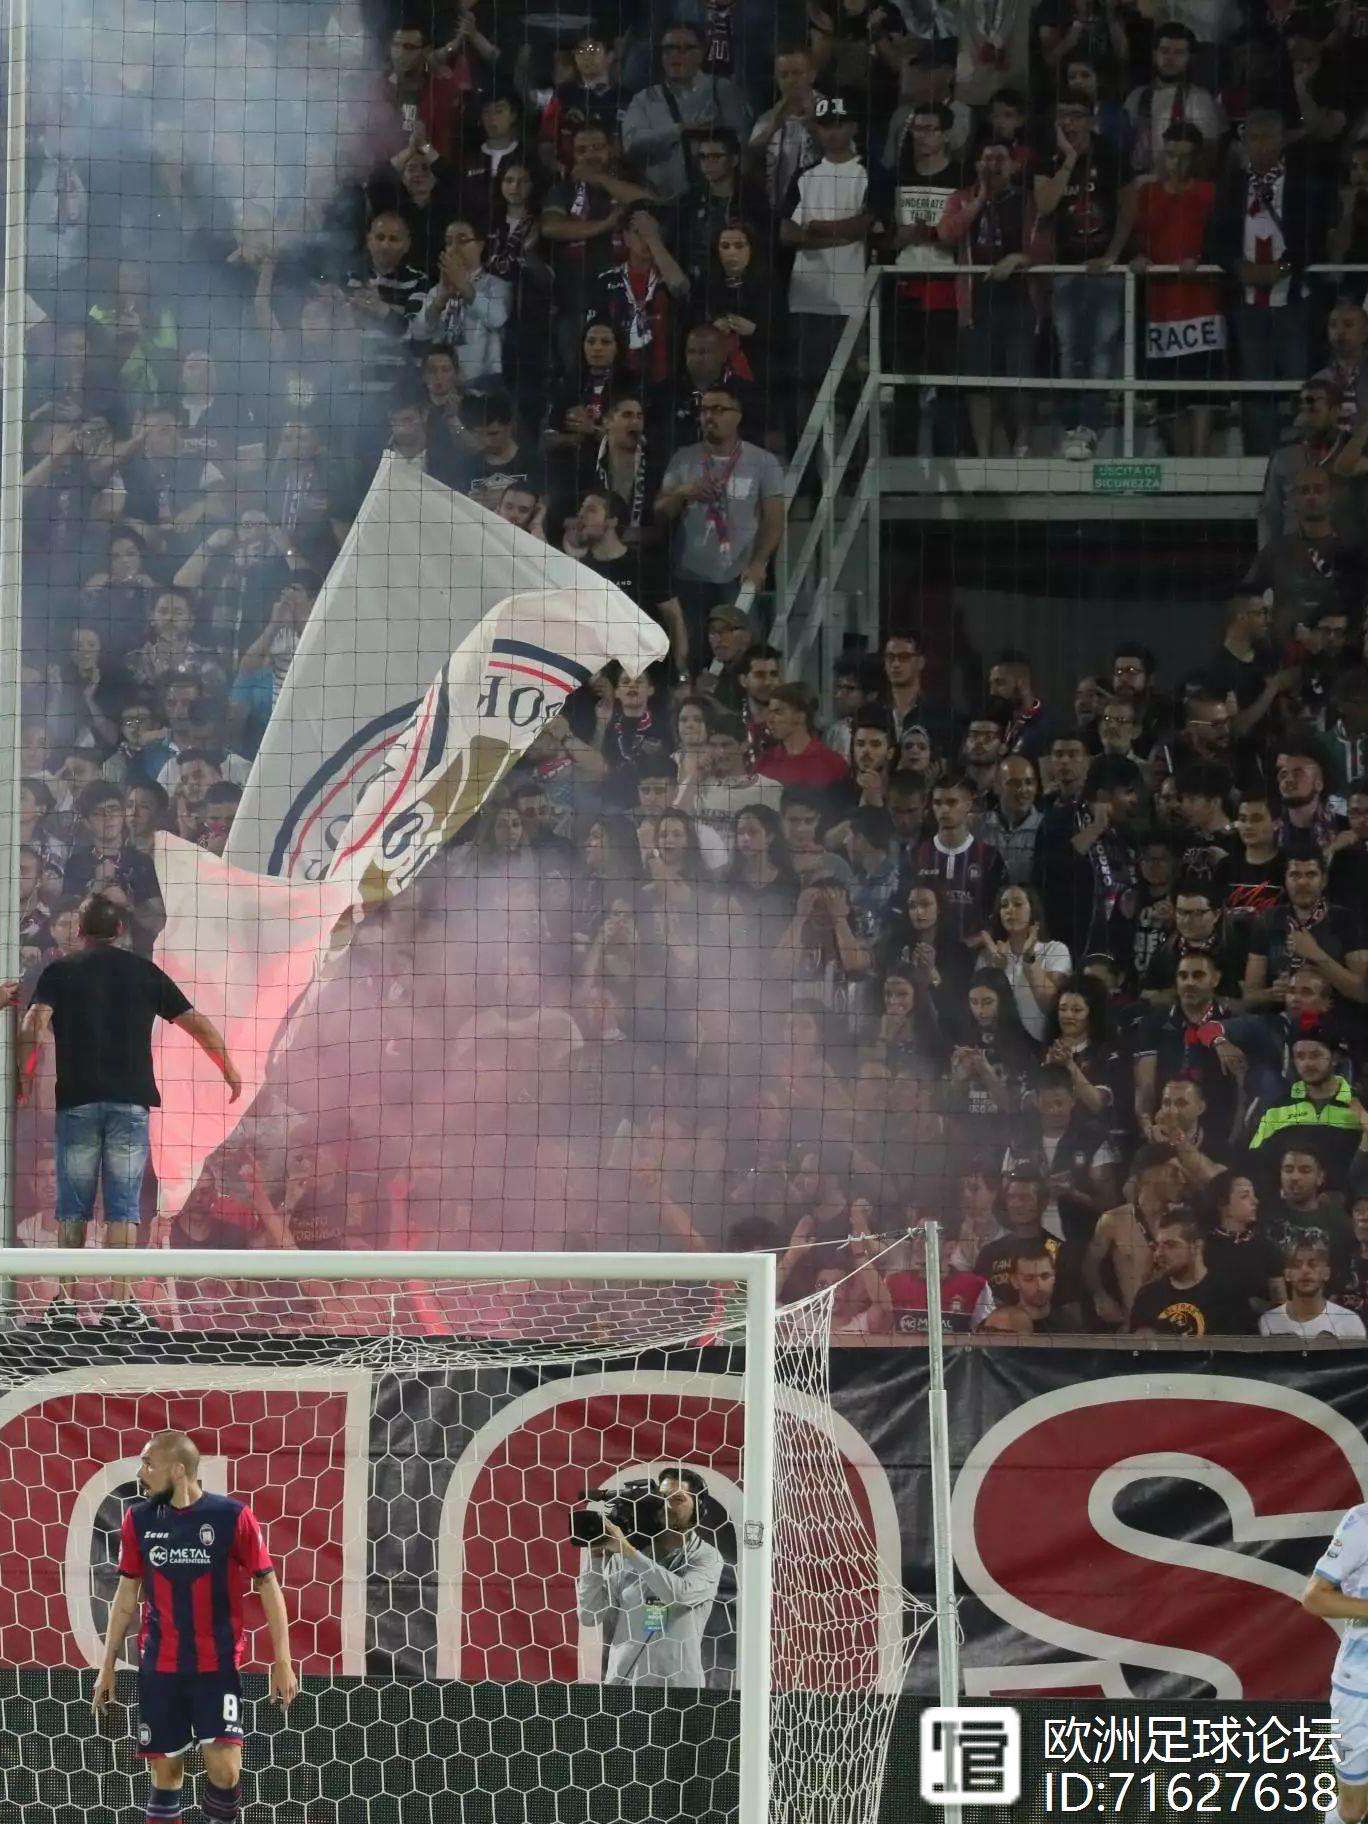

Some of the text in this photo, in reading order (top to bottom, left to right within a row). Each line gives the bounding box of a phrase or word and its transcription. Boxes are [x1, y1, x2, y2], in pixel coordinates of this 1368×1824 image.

[815, 97, 848, 118] 01
[1148, 320, 1218, 353] RACE
[1099, 466, 1141, 477] USCITA
[1094, 478, 1161, 489] SICUREZZA
[169, 1547, 211, 1558] METAL
[223, 1693, 238, 1722] 8
